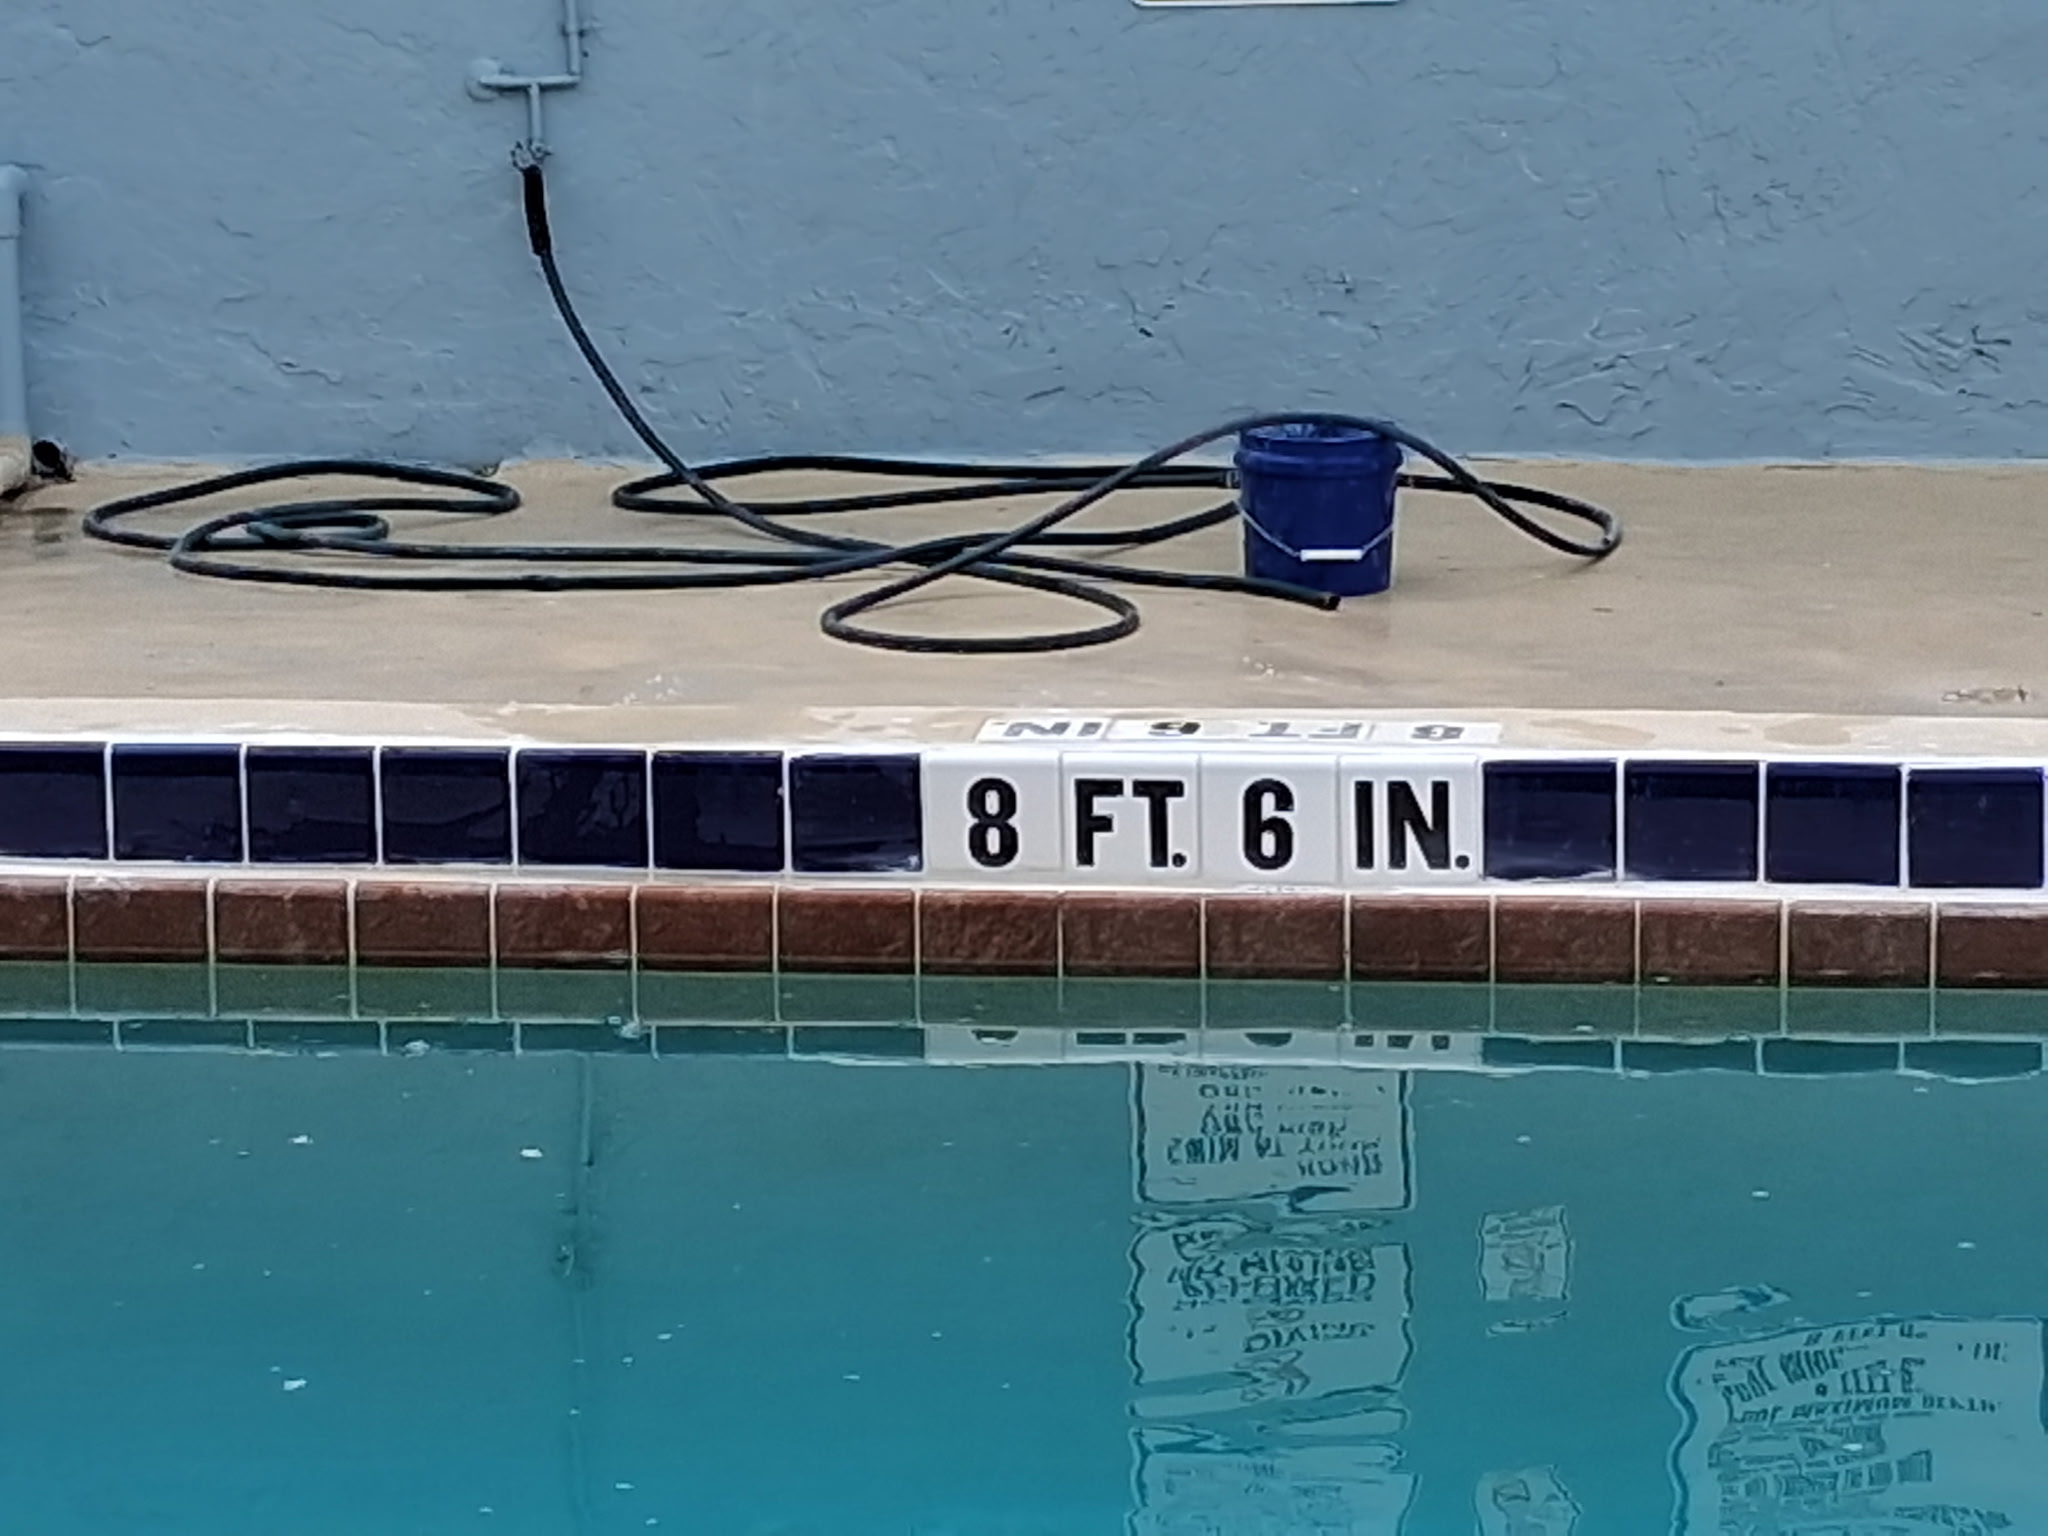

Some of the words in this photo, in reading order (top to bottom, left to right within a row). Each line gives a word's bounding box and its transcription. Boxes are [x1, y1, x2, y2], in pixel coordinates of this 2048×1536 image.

[1147, 721, 1202, 737] 6
[966, 777, 1020, 868] 8
[1073, 778, 1188, 868] FT.
[1242, 778, 1295, 869] 6
[1353, 779, 1471, 870] IN.
